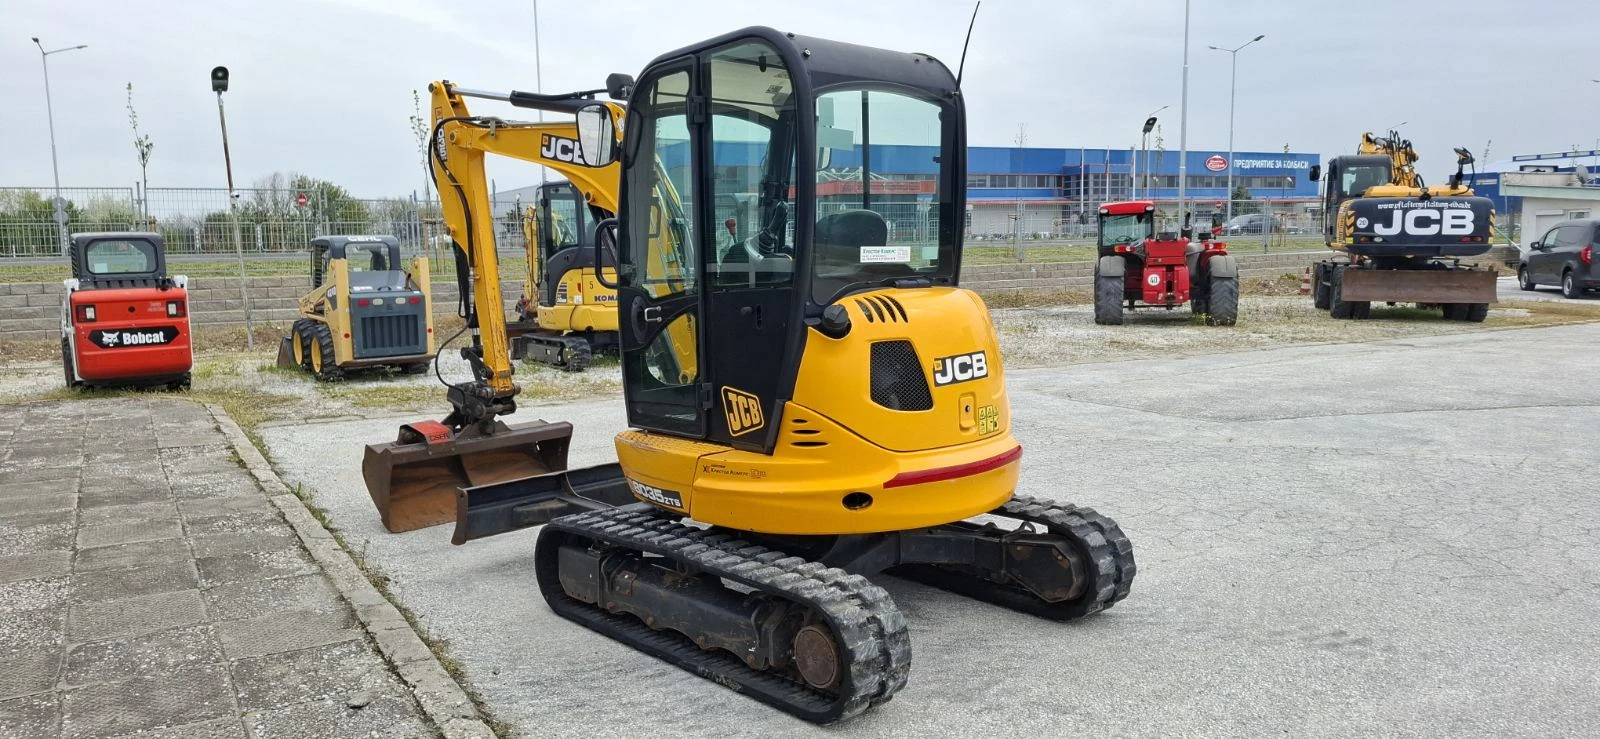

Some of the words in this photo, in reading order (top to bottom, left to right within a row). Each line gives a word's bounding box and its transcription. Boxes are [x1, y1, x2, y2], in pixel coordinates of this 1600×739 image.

[1233, 160, 1274, 169] ПРЕДПРИЯТИЕ
[1275, 160, 1282, 168] ЗА
[1283, 160, 1309, 169] КОЛБАСИ
[1373, 209, 1475, 236] JCB
[589, 280, 594, 290] 5
[122, 331, 165, 345] Bobcat
[935, 352, 988, 384] JCB
[727, 392, 761, 431] JCB
